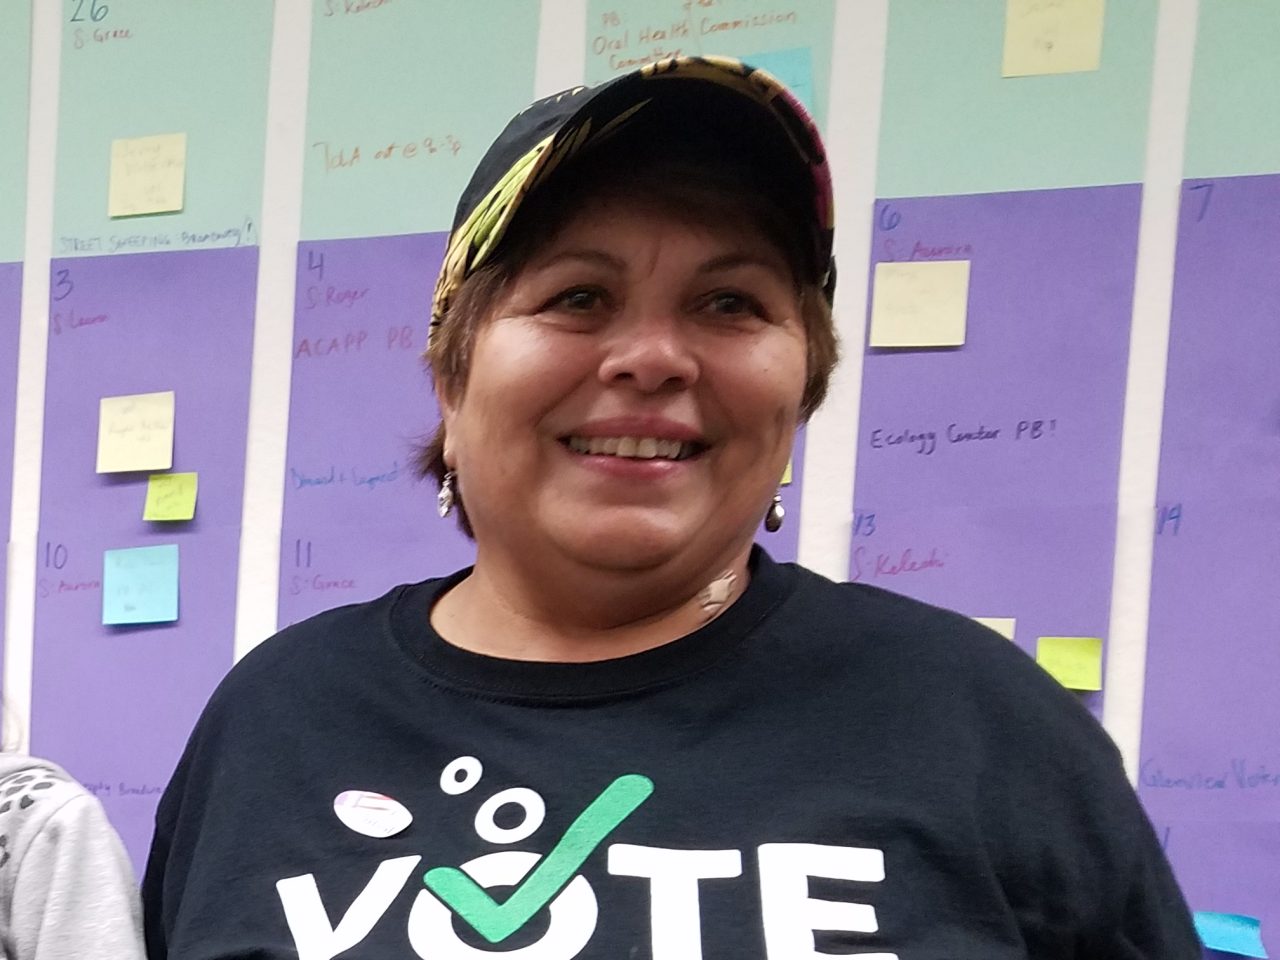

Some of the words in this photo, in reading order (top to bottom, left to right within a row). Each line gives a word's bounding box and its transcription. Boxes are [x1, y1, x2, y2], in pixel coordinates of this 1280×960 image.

[70, 0, 110, 23] 26
[592, 30, 629, 55] Oral
[639, 18, 689, 44] Health
[701, 11, 797, 36] Commission
[879, 204, 902, 231] 6
[1188, 183, 1215, 223] 7
[308, 250, 325, 282] 4
[53, 269, 75, 301] 3
[294, 331, 368, 359] ACAPP
[870, 428, 937, 455] Ecology
[947, 424, 1000, 446] Center
[852, 513, 877, 537] 13
[45, 541, 69, 570] 10
[295, 539, 312, 568] 11
[312, 577, 356, 591] Grace
